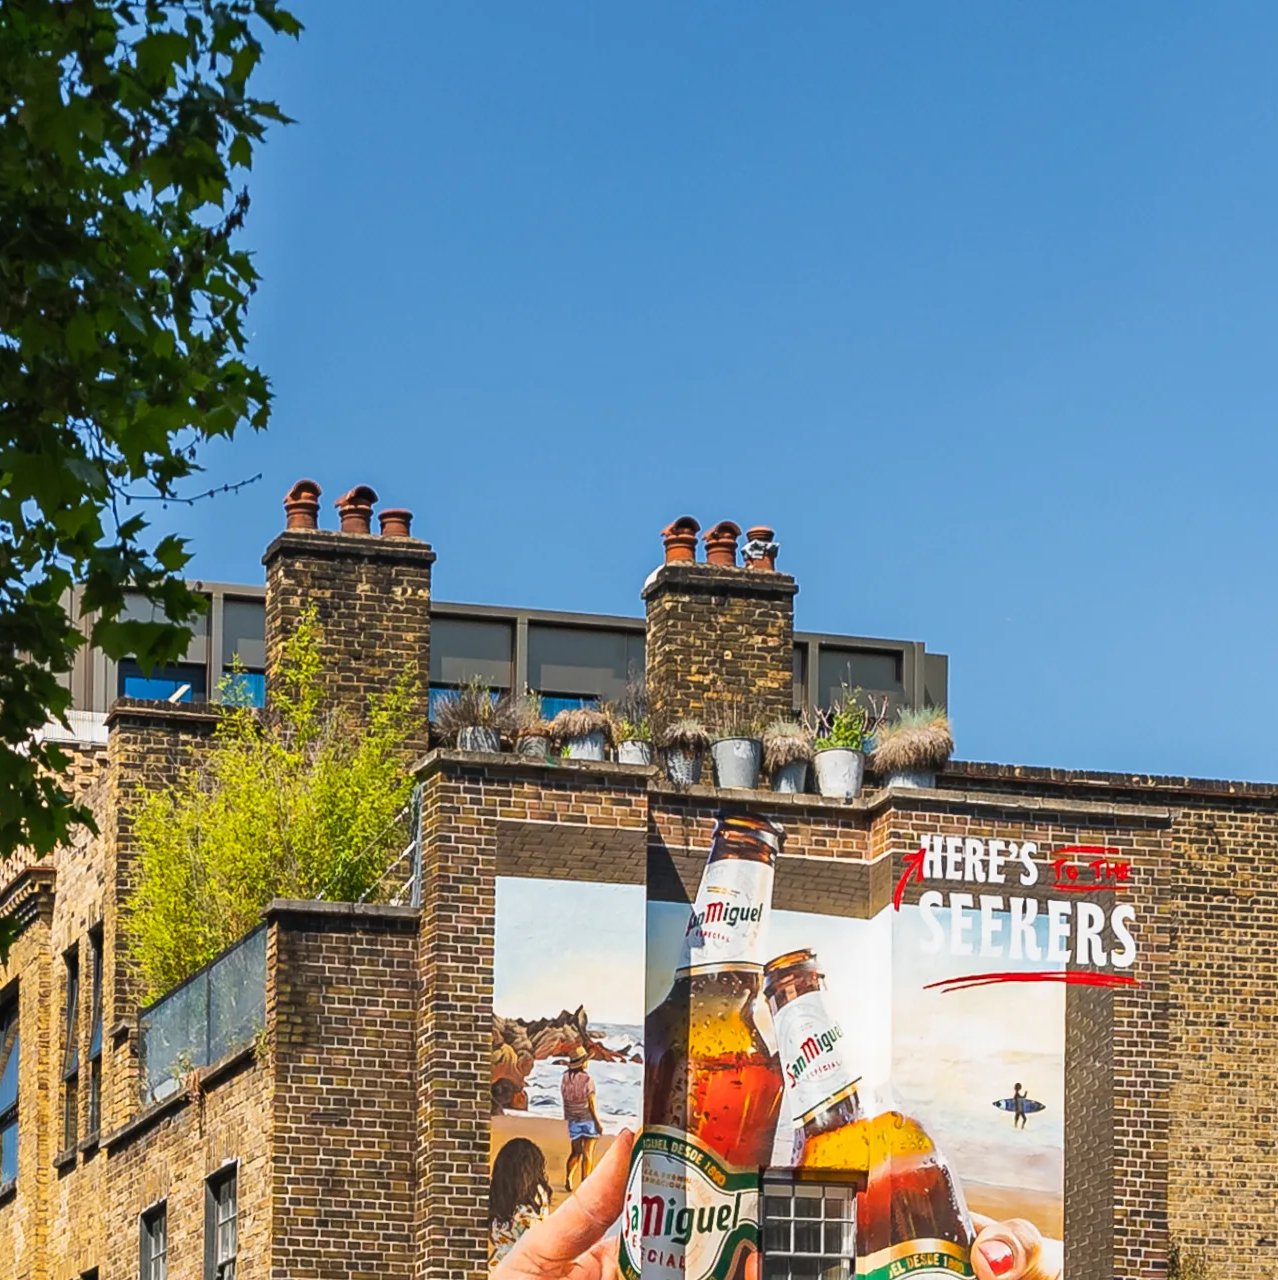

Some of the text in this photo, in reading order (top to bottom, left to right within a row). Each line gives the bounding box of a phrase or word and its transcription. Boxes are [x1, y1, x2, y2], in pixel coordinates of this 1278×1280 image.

[921, 834, 1039, 886] HERE'S
[1088, 858, 1133, 881] THE
[919, 890, 1137, 968] SEEKERS
